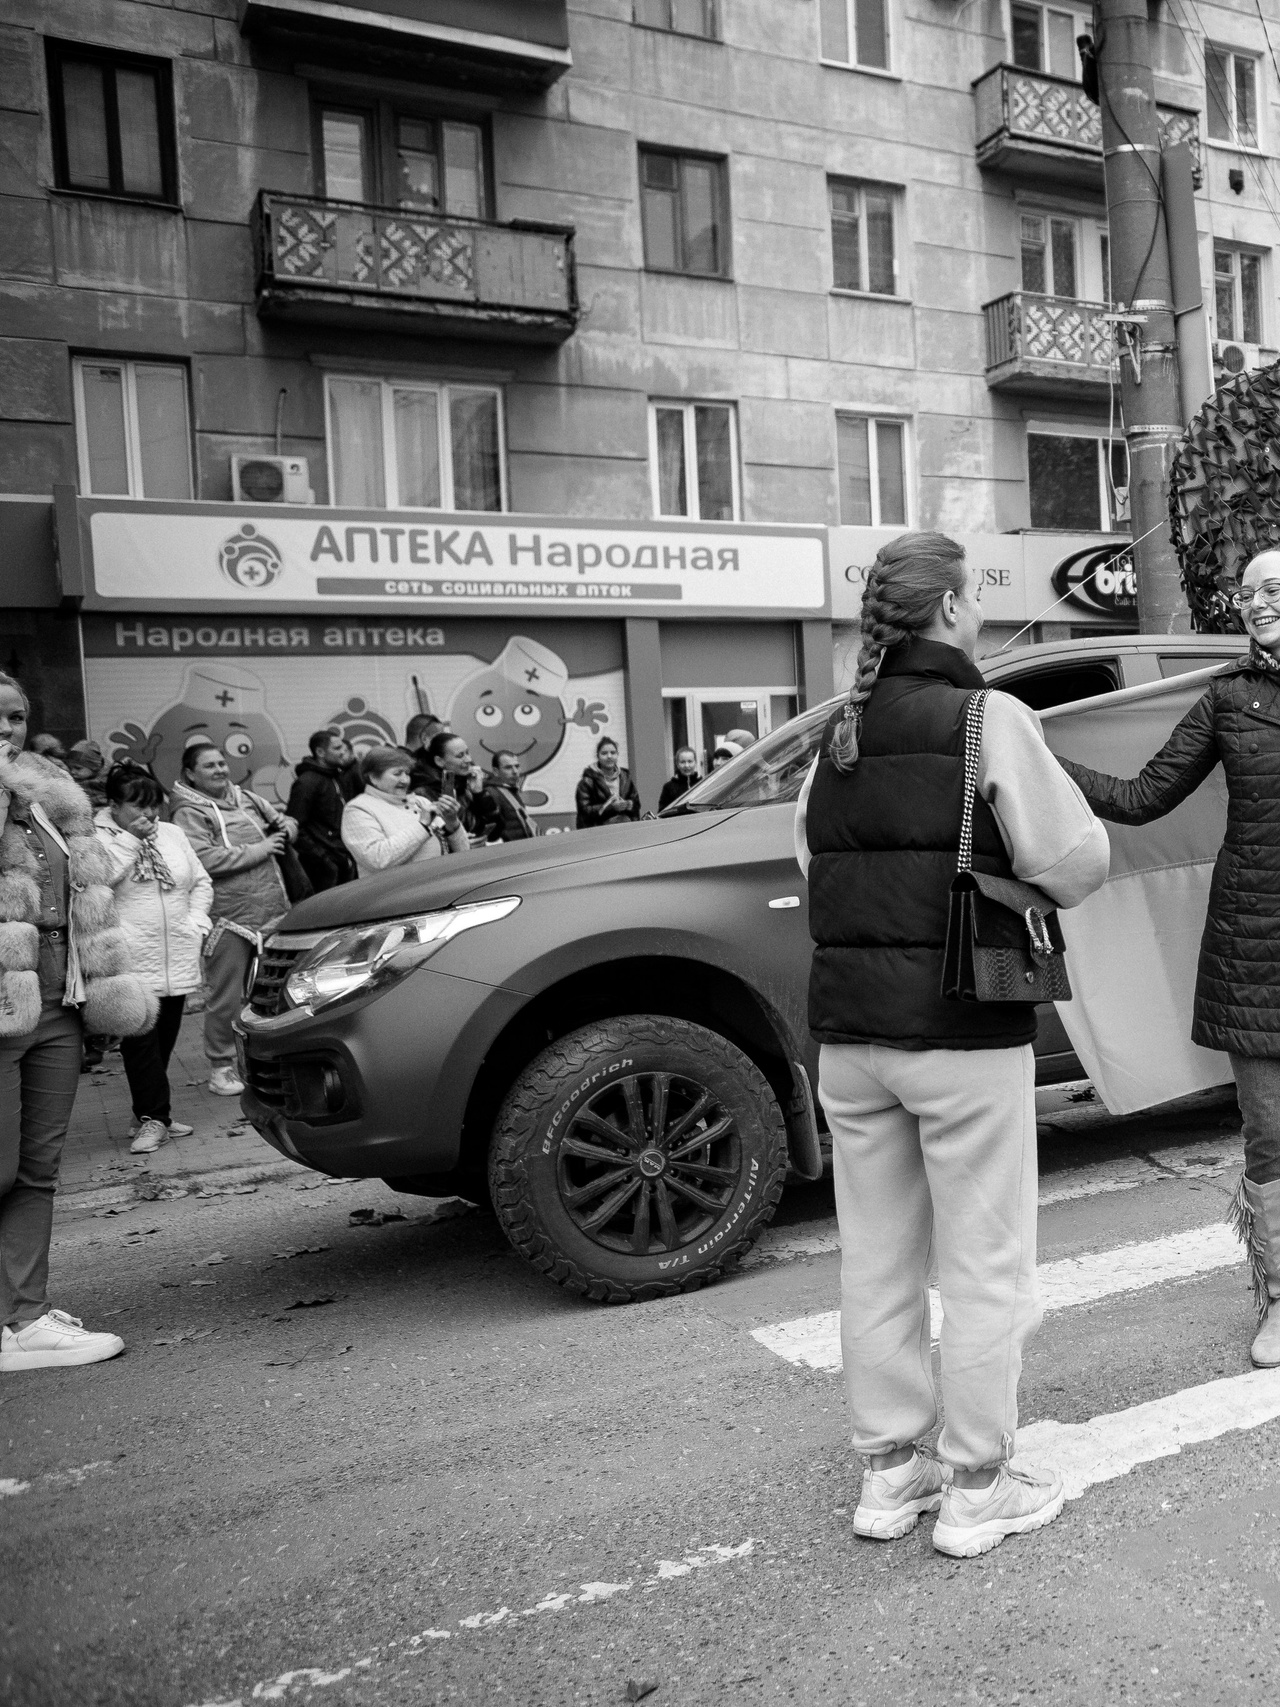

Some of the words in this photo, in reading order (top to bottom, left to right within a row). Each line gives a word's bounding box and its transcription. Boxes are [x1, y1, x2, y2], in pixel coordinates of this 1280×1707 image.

[310, 525, 493, 566] АПТЕКА
[509, 533, 740, 575] Народная
[385, 581, 434, 595] сеть
[441, 582, 569, 598] социальных
[576, 584, 632, 599] аптек
[115, 621, 309, 652] Народная
[322, 627, 445, 647] аптека
[542, 1059, 633, 1155] BFGoodrich
[698, 1158, 759, 1254] All-Terrain
[658, 1255, 690, 1270] T/A
